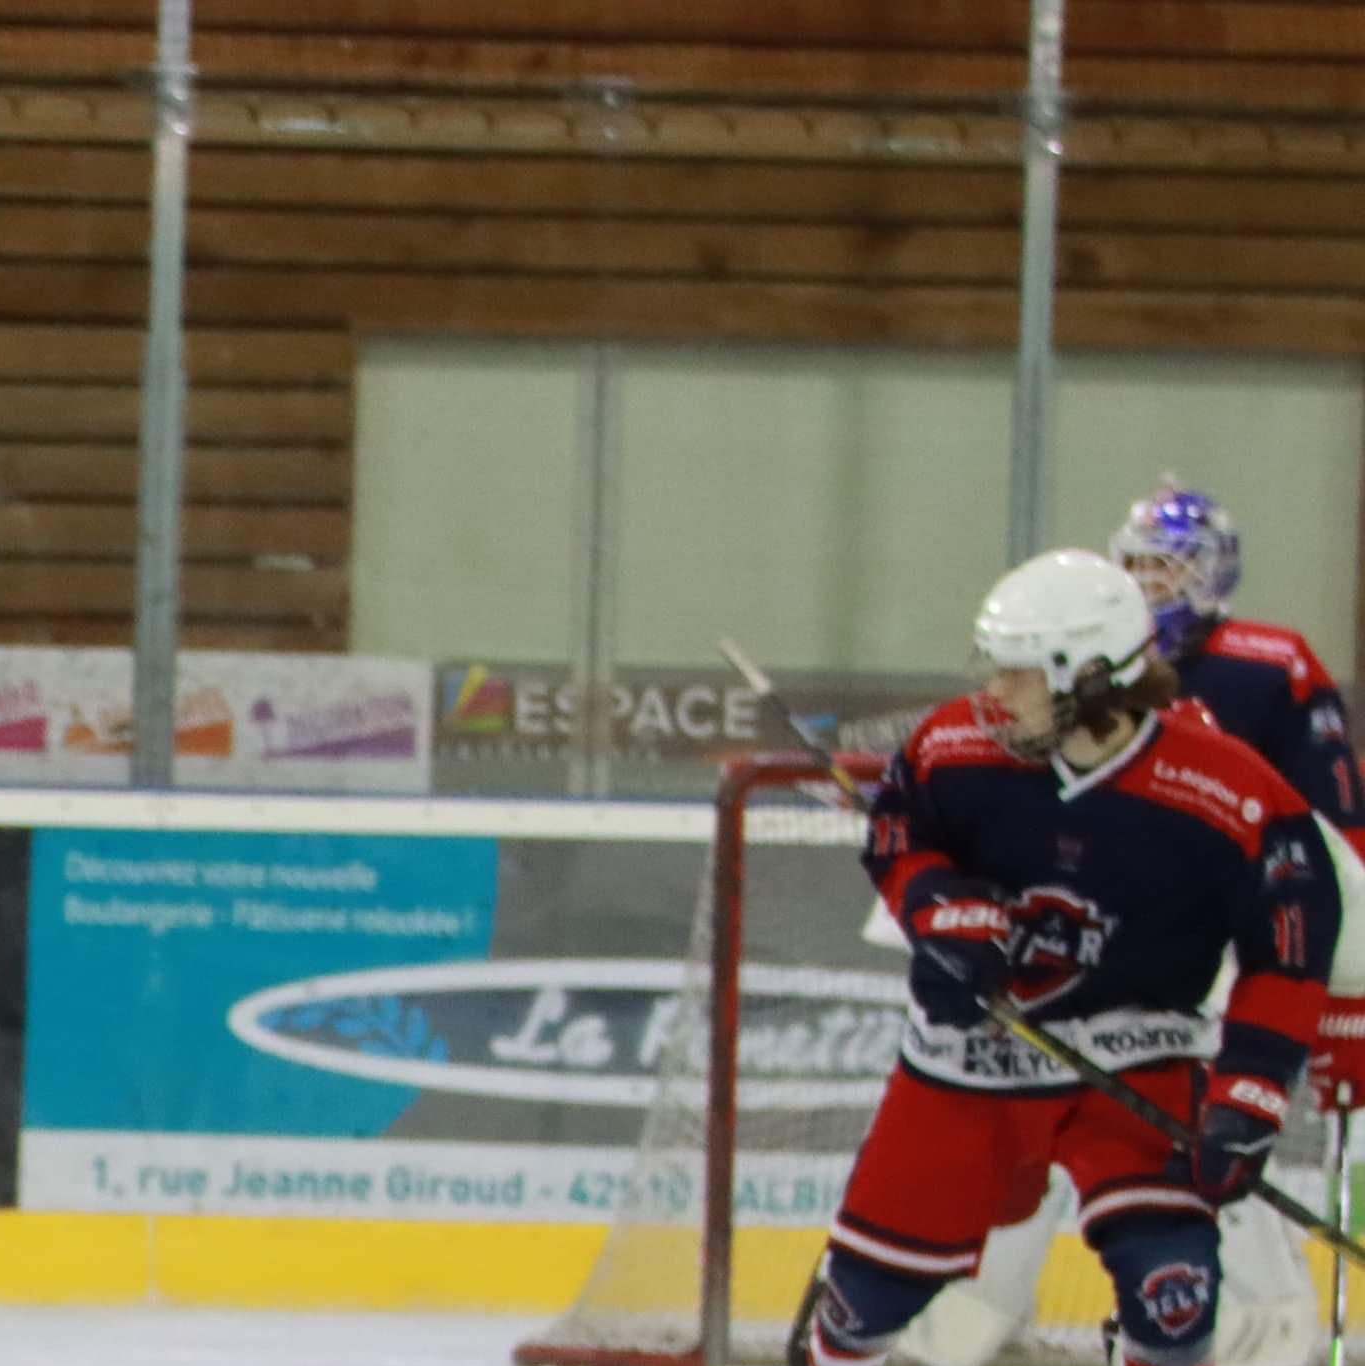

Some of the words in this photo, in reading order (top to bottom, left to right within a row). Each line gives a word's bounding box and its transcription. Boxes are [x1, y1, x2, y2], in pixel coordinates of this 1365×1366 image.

[138, 1163, 209, 1197] rue
[220, 1162, 372, 1203] Jeanne
[385, 1164, 525, 1207] Giroud
